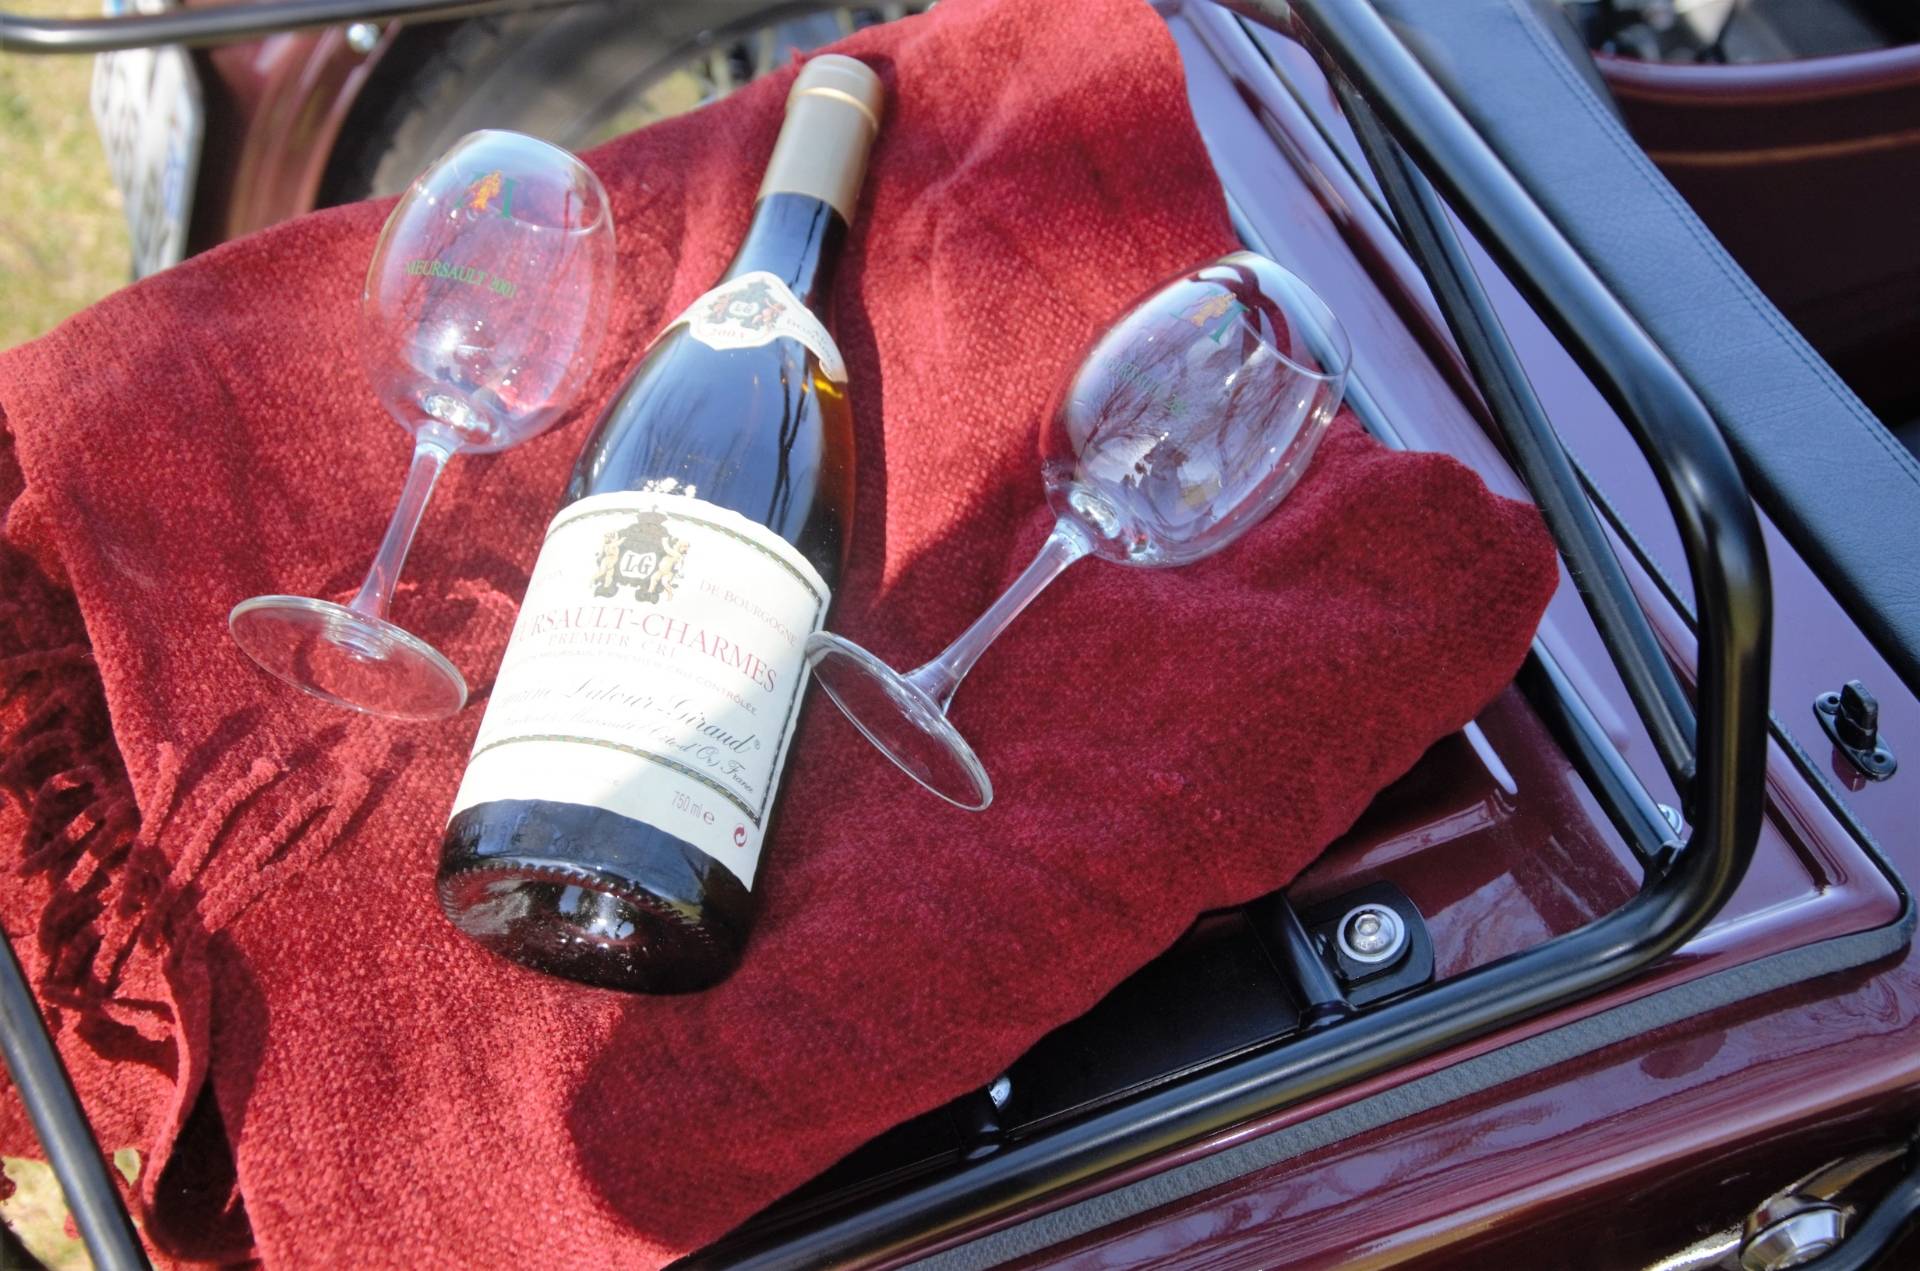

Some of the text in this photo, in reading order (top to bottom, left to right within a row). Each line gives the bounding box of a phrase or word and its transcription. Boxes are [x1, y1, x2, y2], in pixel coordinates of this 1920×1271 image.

[622, 553, 653, 575] LG
[724, 588, 799, 648] BOURGOGNE
[671, 790, 691, 812] 750
